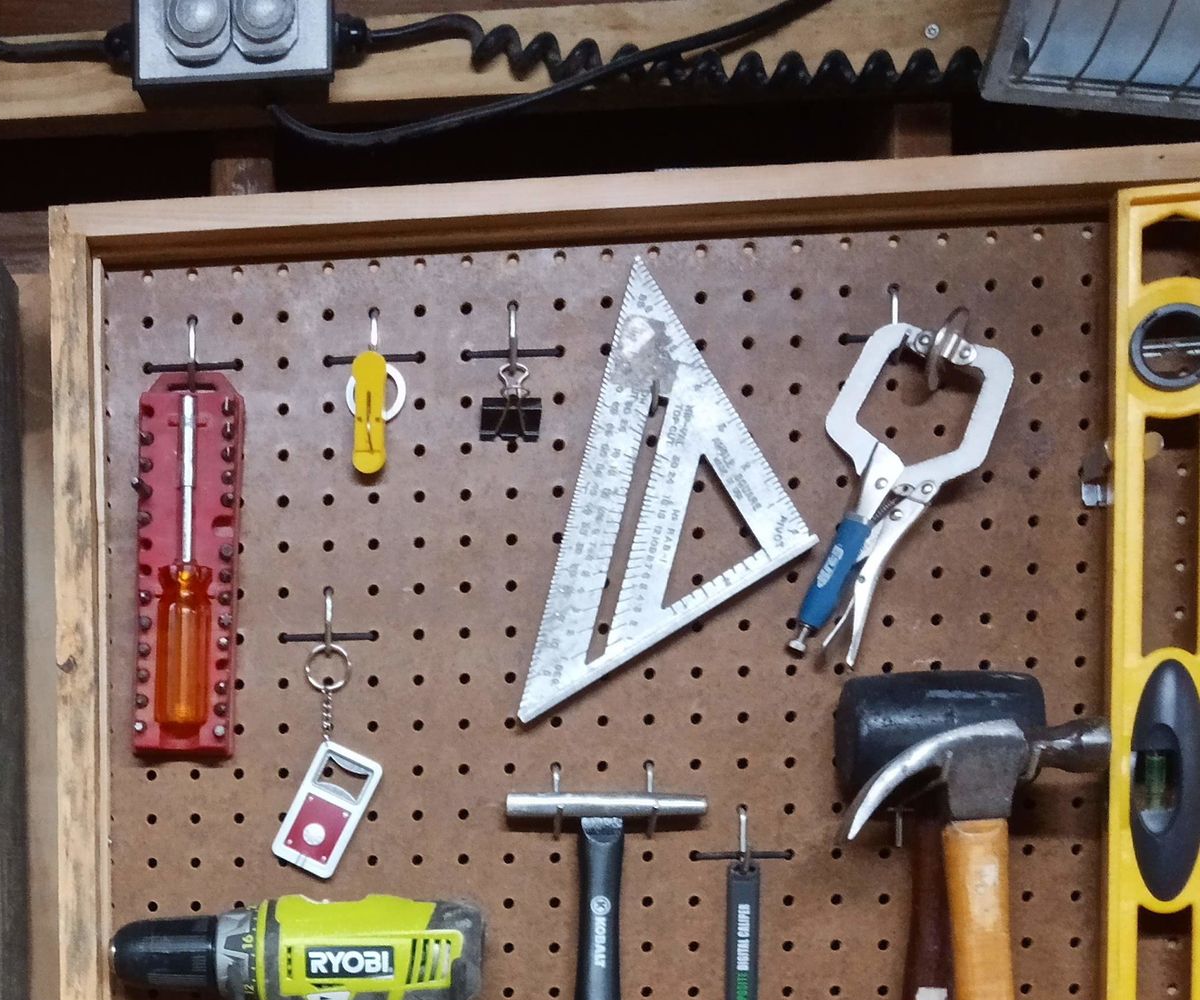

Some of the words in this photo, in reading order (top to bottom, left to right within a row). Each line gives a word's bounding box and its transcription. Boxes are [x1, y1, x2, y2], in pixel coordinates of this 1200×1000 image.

[666, 426, 678, 446] CUT
[773, 514, 787, 549] PIVOT
[738, 903, 750, 936] CALIPER
[242, 935, 254, 949] 16
[594, 916, 606, 968] KOBALT
[737, 938, 749, 971] DIGITAL
[308, 951, 390, 974] RYOBI
